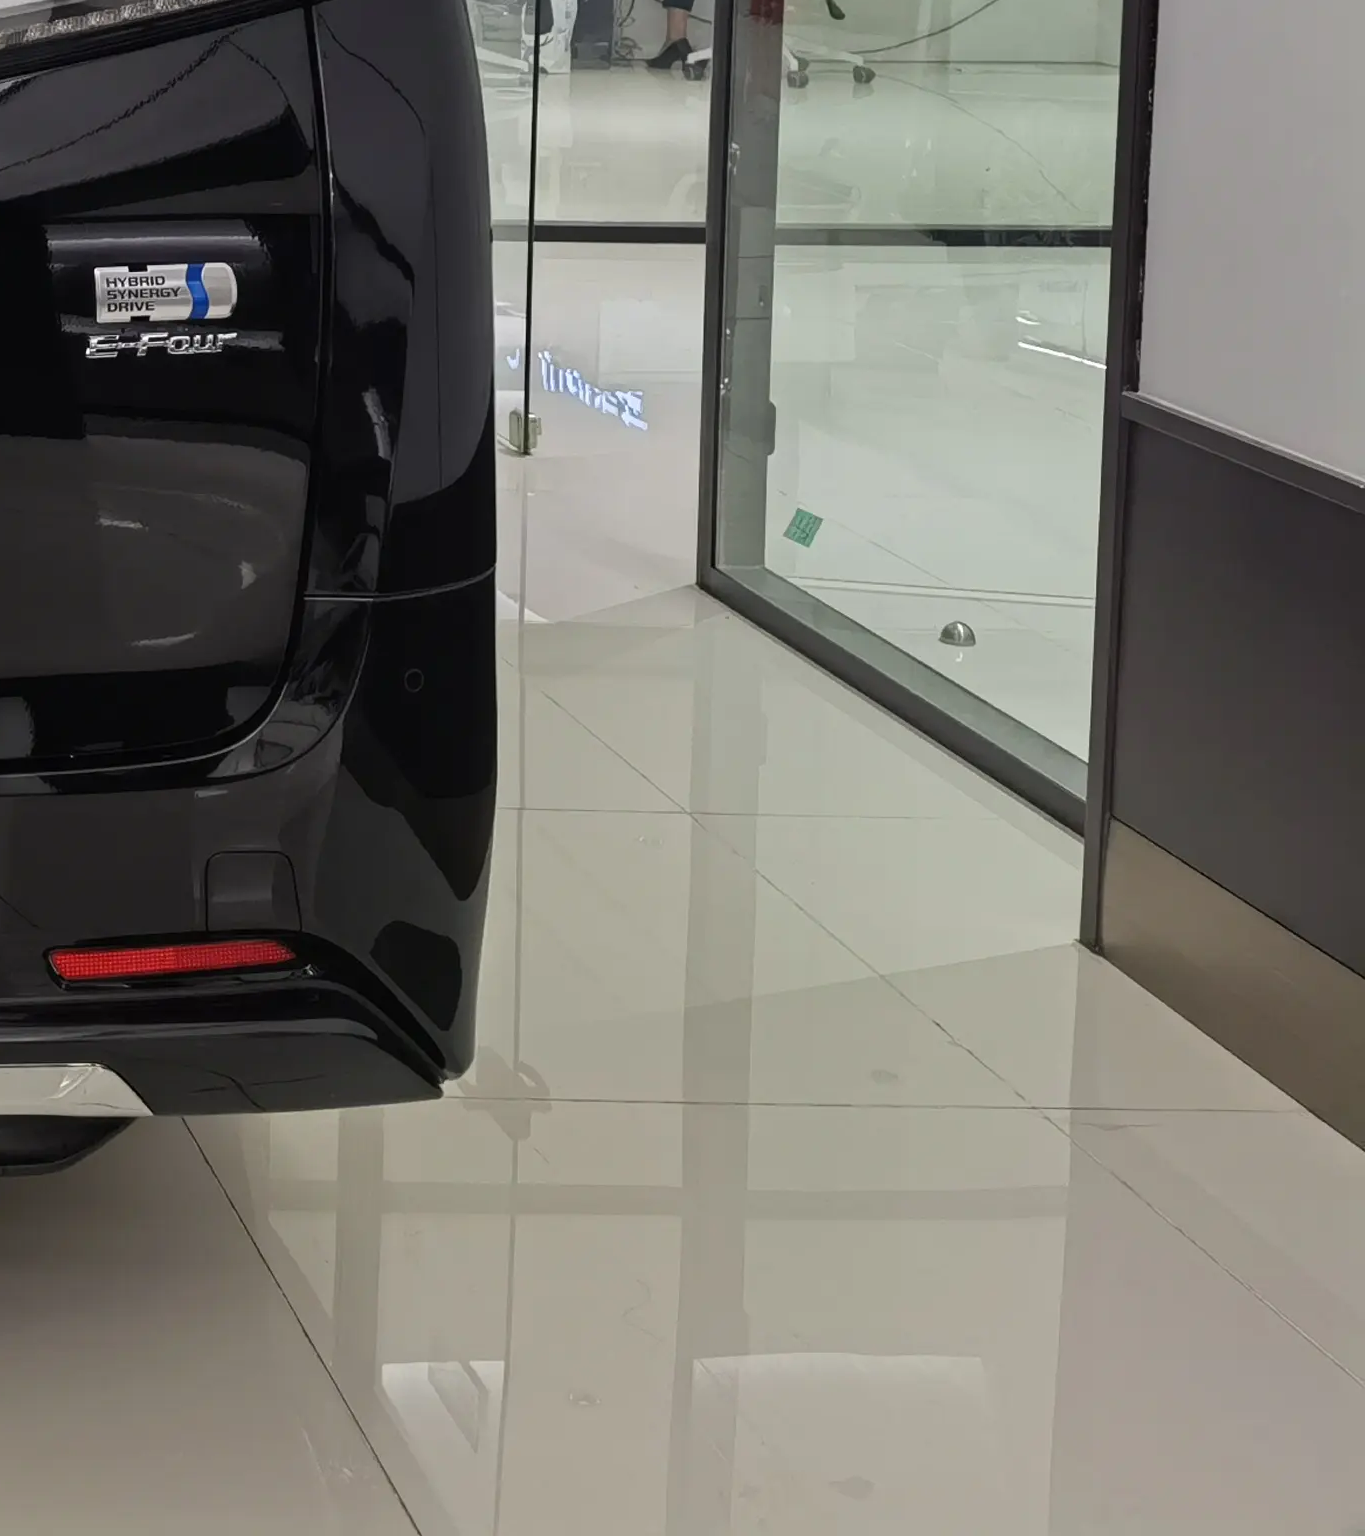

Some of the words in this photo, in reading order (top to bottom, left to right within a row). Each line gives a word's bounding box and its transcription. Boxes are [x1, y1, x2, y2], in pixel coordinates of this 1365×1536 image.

[105, 275, 166, 288] HYBRID
[106, 287, 181, 301] SYNERGY
[107, 300, 156, 313] DRIVE
[85, 332, 238, 358] E-Four
